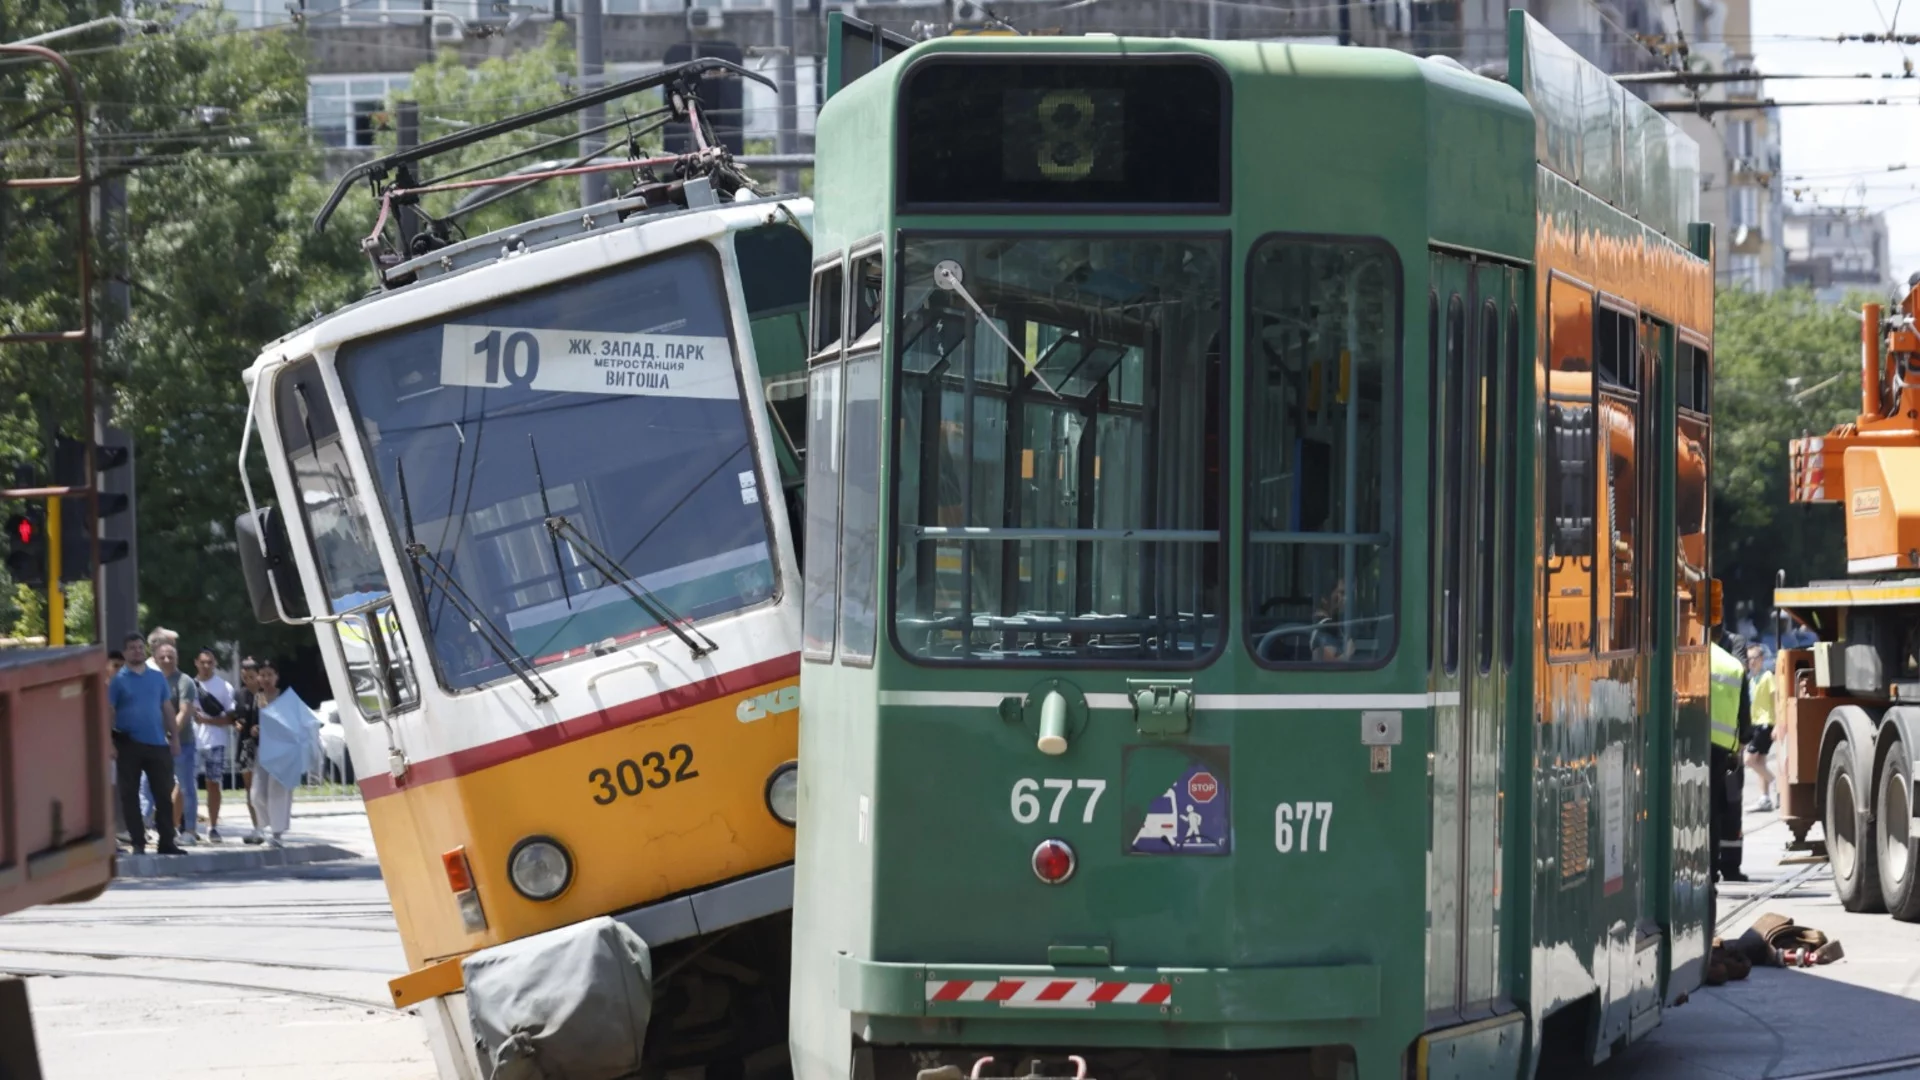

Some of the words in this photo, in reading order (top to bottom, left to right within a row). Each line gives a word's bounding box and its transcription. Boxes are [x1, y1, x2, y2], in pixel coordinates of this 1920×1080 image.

[1038, 95, 1095, 181] 8
[474, 330, 540, 388] 10
[568, 338, 597, 356] ЖК.
[601, 340, 660, 360] ЗАПАД.
[665, 343, 705, 361] ПАРК
[594, 358, 685, 372] МЕТРОСТАНЦИЯ
[605, 370, 670, 389] ВИТОША
[588, 743, 699, 806] 3032
[1191, 783, 1215, 792] STOP
[1011, 778, 1106, 824] 677
[1275, 802, 1333, 853] 677
